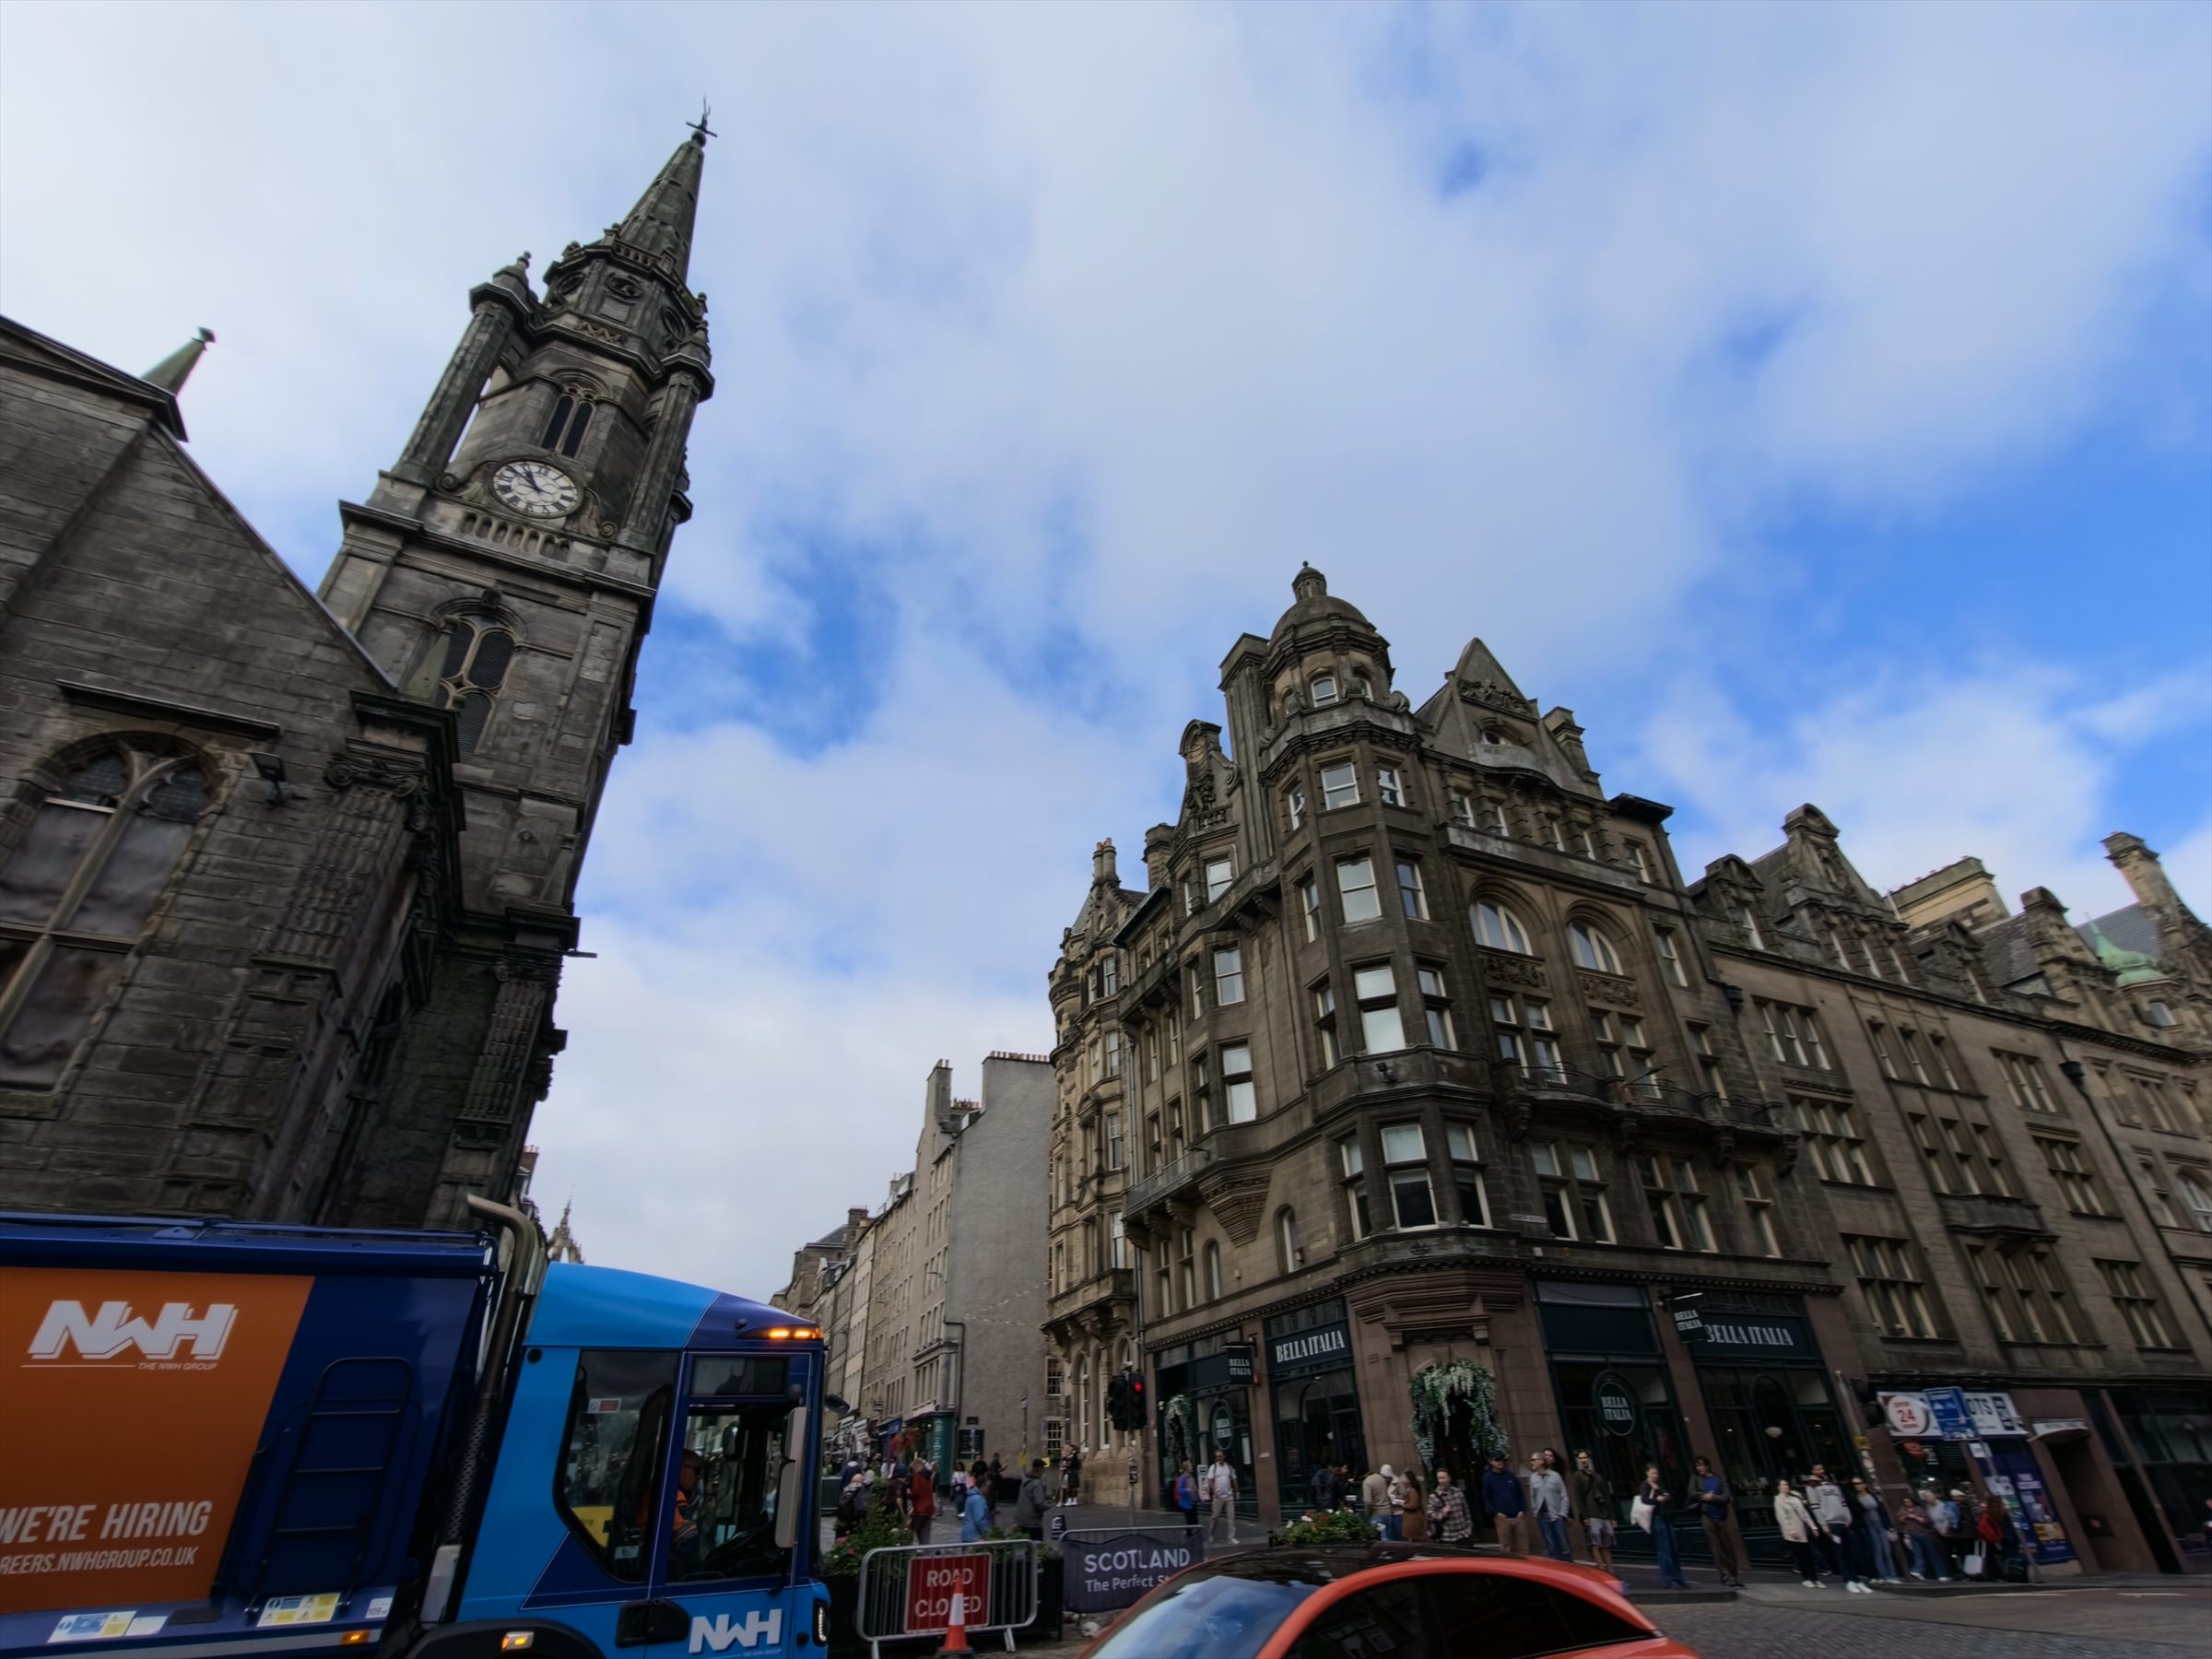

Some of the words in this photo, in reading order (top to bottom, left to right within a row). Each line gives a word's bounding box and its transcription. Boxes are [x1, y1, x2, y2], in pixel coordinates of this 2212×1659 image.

[27, 1300, 240, 1359] NWH
[1704, 1324, 1749, 1344] BELLA
[1747, 1326, 1794, 1346] ITALIA
[1275, 1339, 1309, 1363] BELLA
[1307, 1330, 1346, 1356] ITALIA
[137, 1362, 158, 1371] THE
[158, 1362, 182, 1371] NWH
[182, 1362, 218, 1371] GROUP
[1896, 1408, 1916, 1422] 24
[0, 1504, 97, 1544] WE'RE
[100, 1500, 213, 1539] HIRING
[1084, 1548, 1191, 1572] SCOTLAND
[926, 1568, 973, 1587] ROAD
[1085, 1578, 1110, 1593] The
[1112, 1573, 1154, 1590] Perfect
[914, 1595, 982, 1618] CLOED
[688, 1608, 782, 1653] NWH
